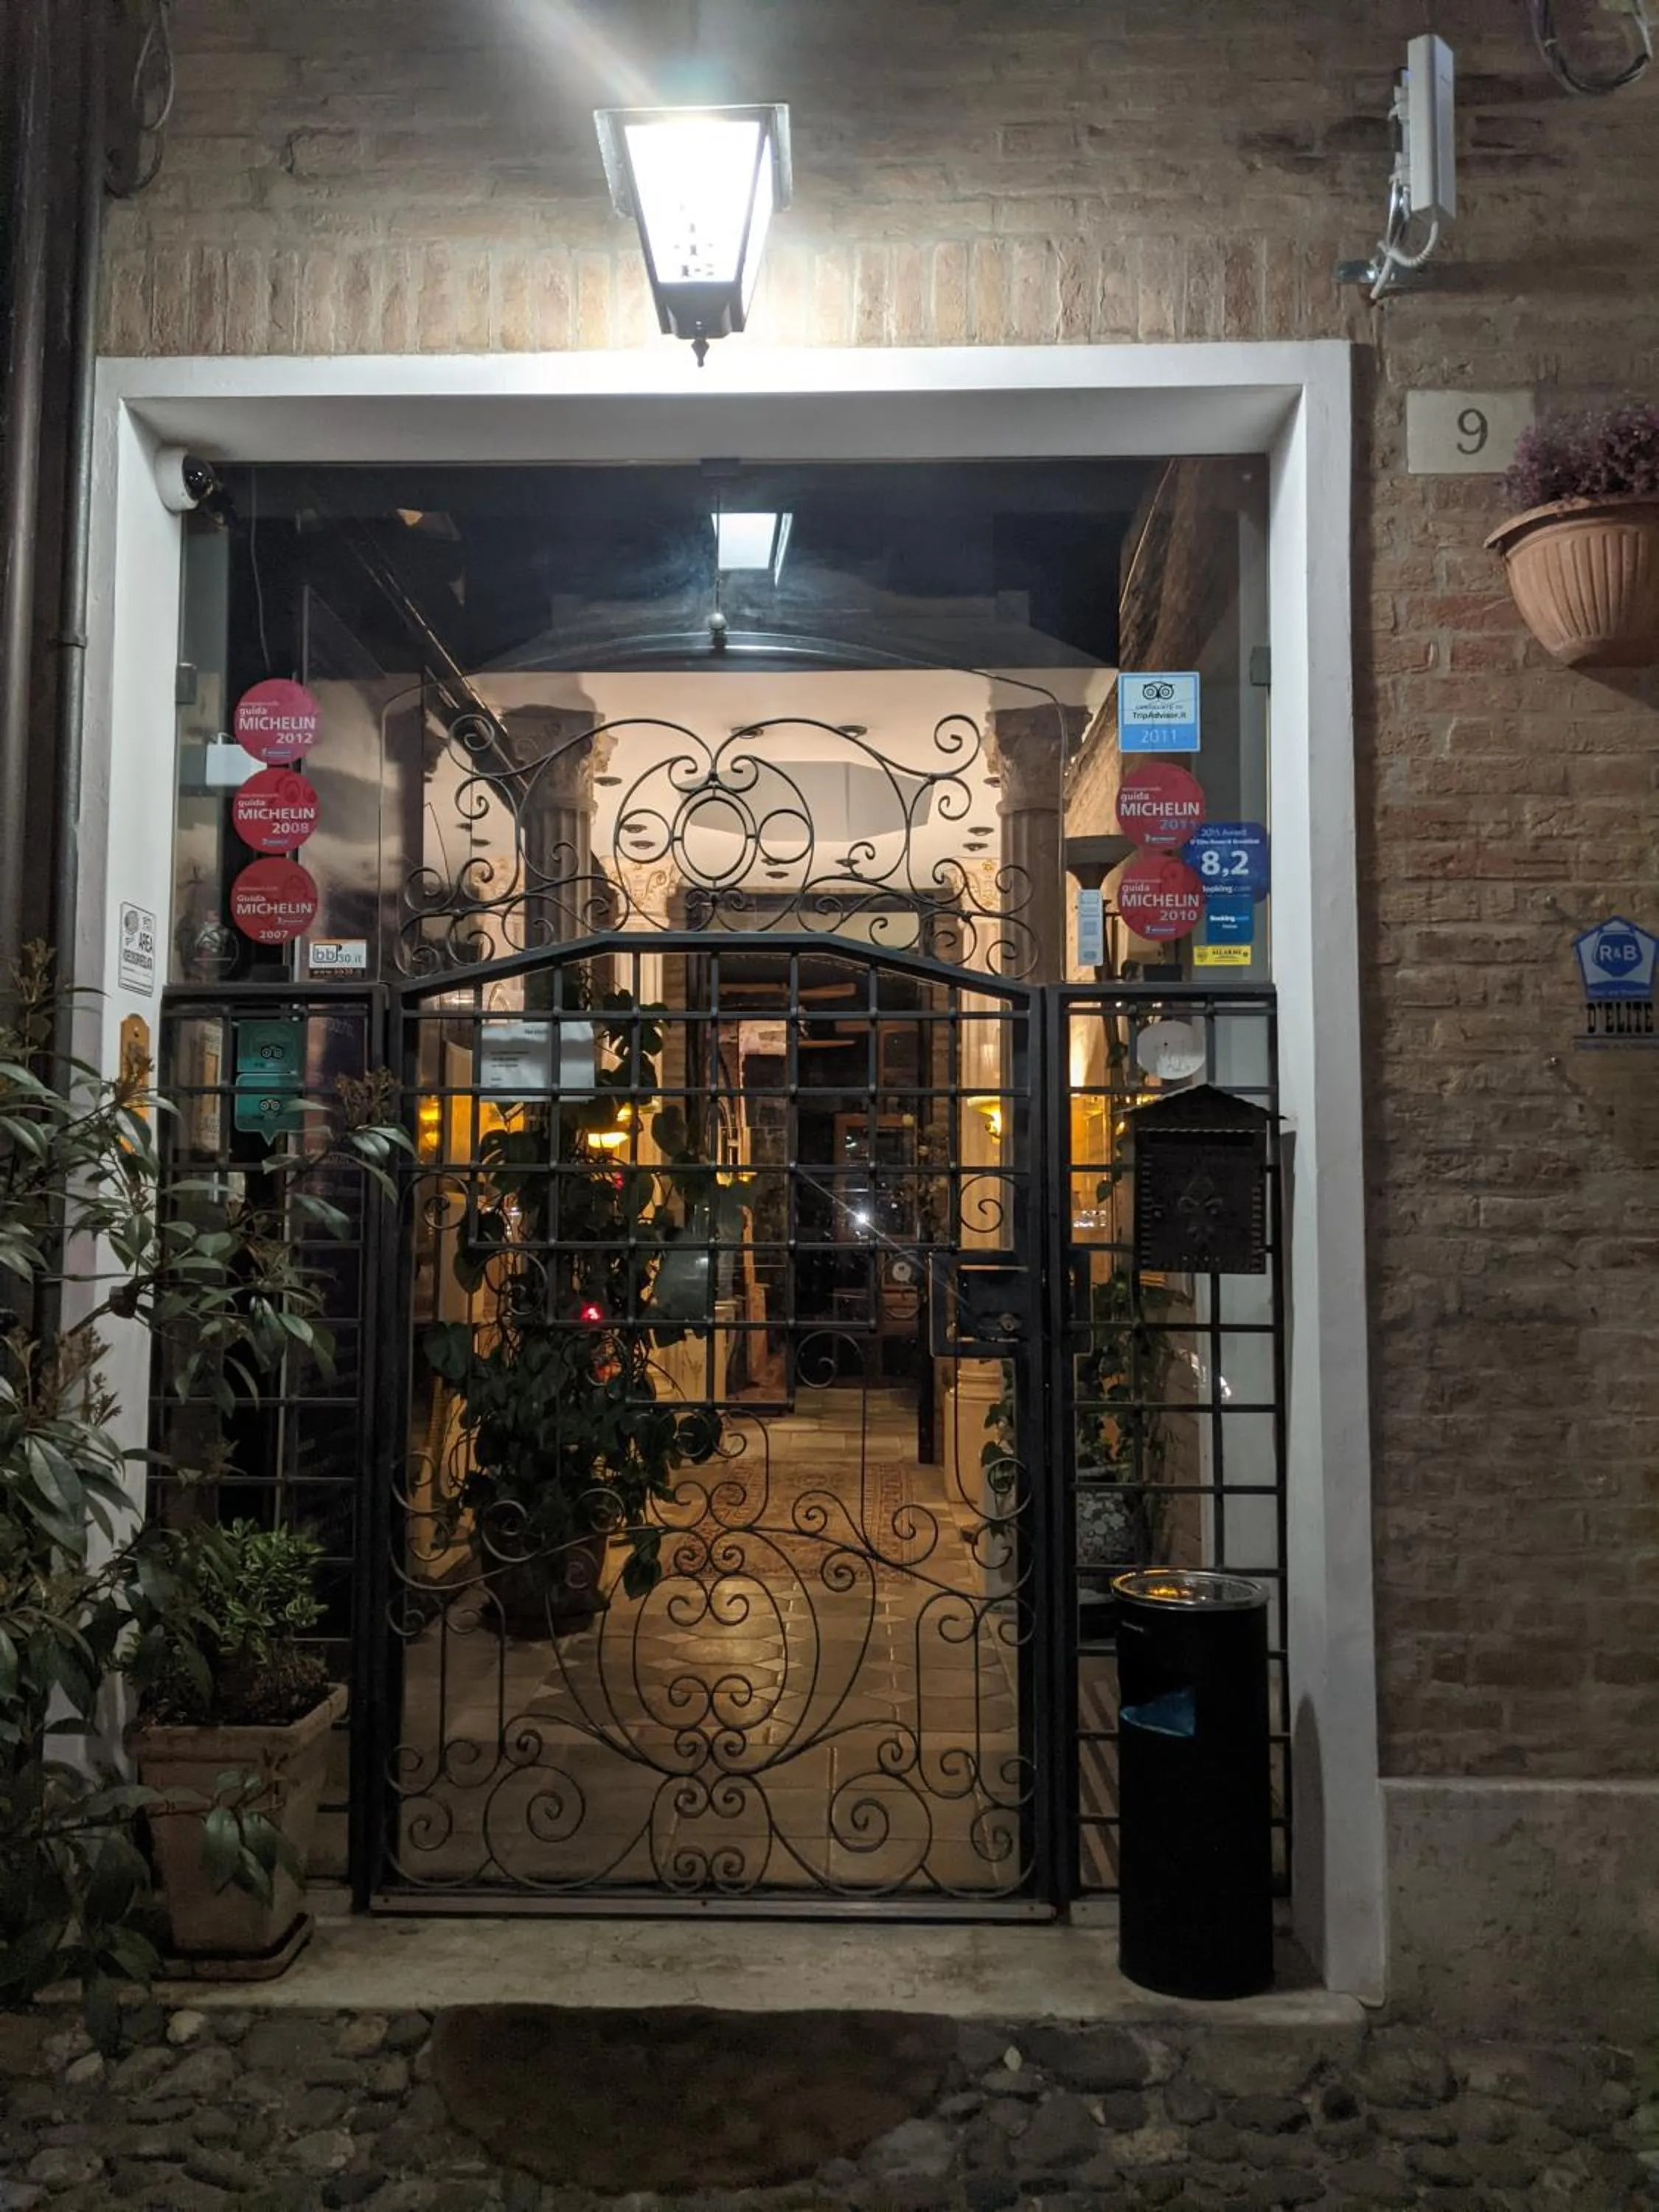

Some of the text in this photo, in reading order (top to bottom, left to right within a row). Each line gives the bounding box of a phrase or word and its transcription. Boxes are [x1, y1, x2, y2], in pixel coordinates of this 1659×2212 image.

[1456, 408, 1488, 455] 9
[240, 706, 268, 717] guida
[239, 717, 316, 731] MICHELIN
[276, 733, 313, 744] 2012
[1141, 729, 1177, 743] 2011
[238, 799, 266, 807] guida
[1121, 792, 1150, 802] guida
[237, 808, 315, 819] MICHELIN
[1121, 802, 1200, 816] MICHELIN
[271, 822, 310, 834] 2008
[1201, 850, 1249, 877] 8,2
[1121, 883, 1150, 893] guida
[1121, 894, 1200, 907] MICHELIN
[237, 902, 312, 914] MICHELIN
[1160, 910, 1197, 921] 2010
[259, 930, 288, 939] 2007
[1599, 945, 1638, 961] R&B
